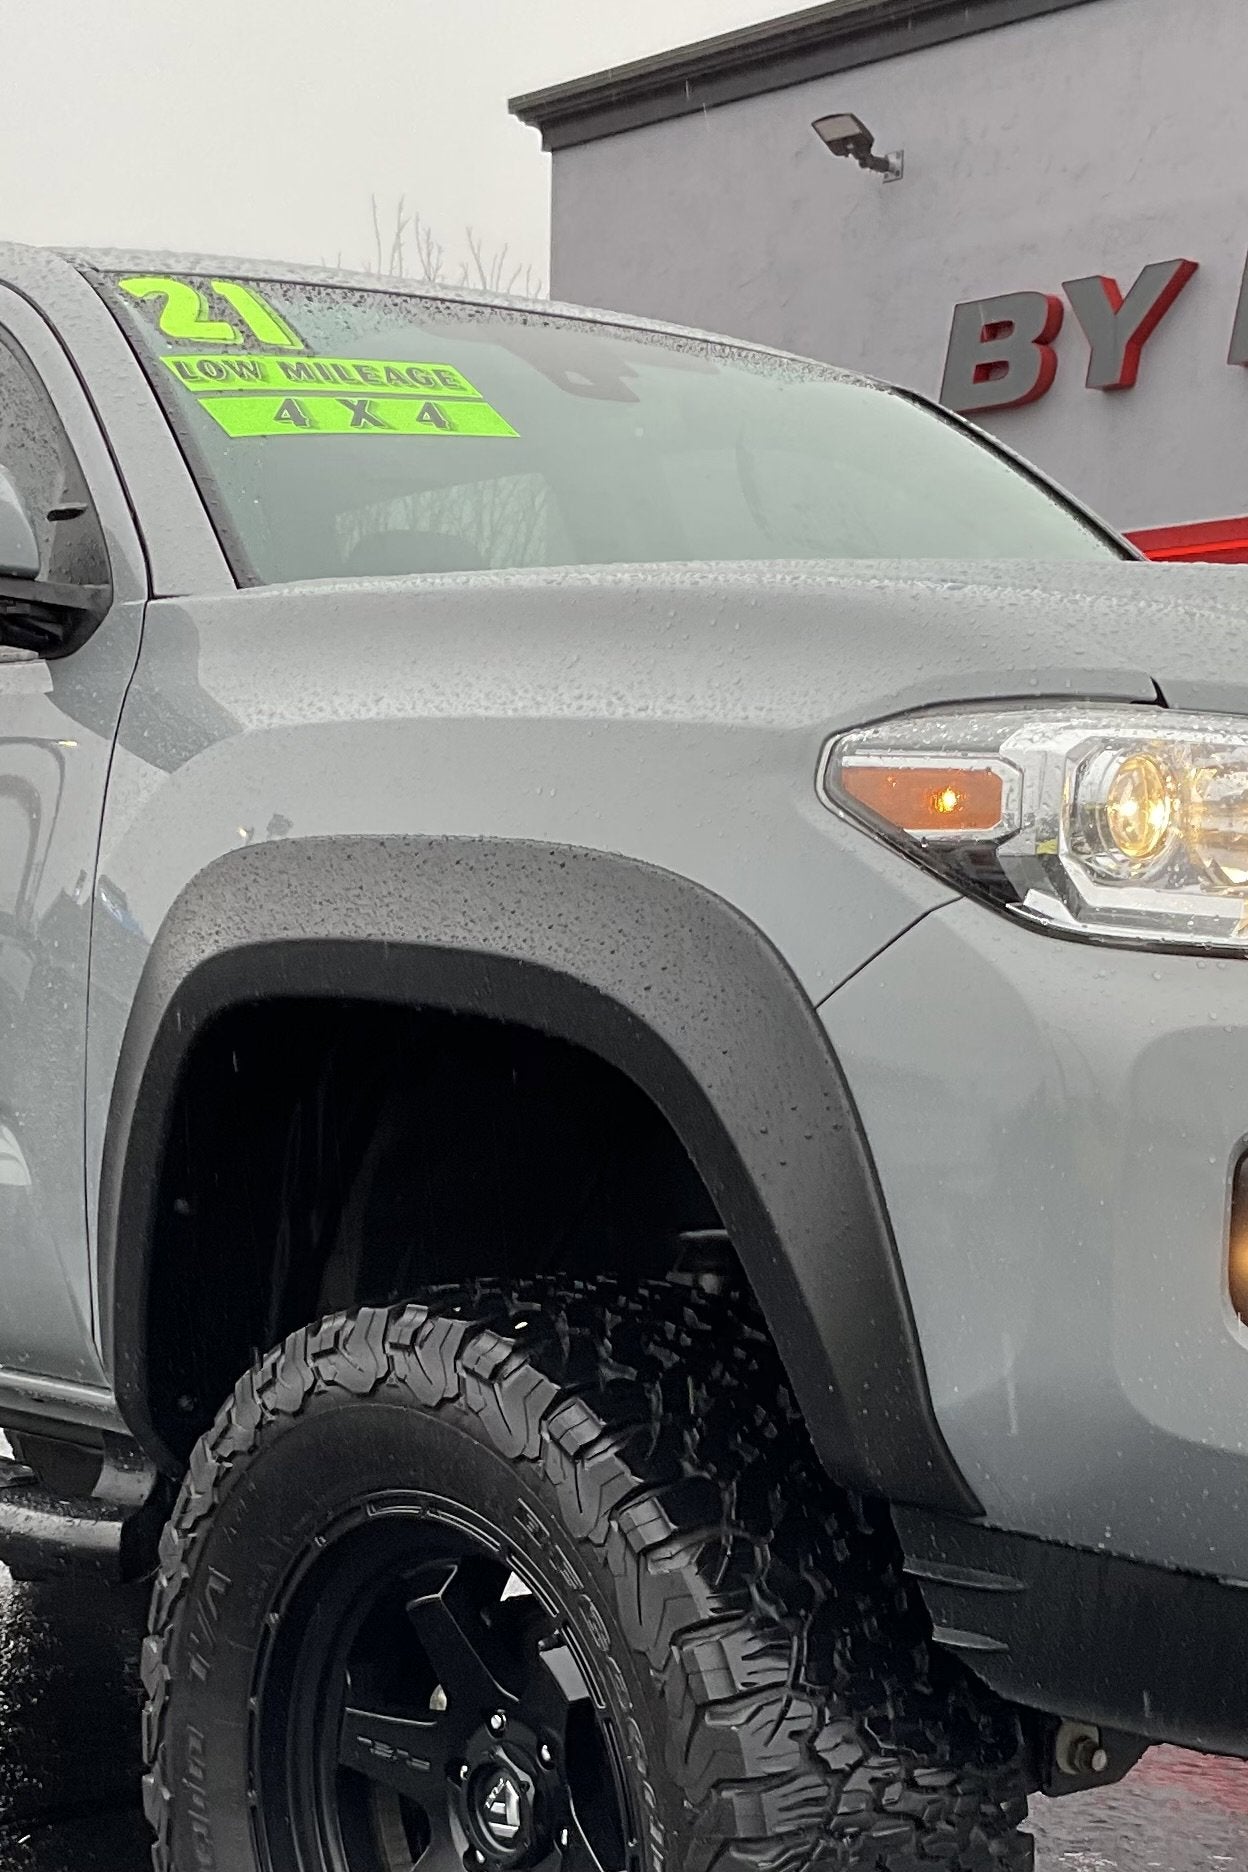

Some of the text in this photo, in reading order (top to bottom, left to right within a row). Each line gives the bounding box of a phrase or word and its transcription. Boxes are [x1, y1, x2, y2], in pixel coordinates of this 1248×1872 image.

[117, 276, 305, 350] 21
[939, 257, 1199, 416] BY
[172, 358, 463, 391] LOW MILEAGE
